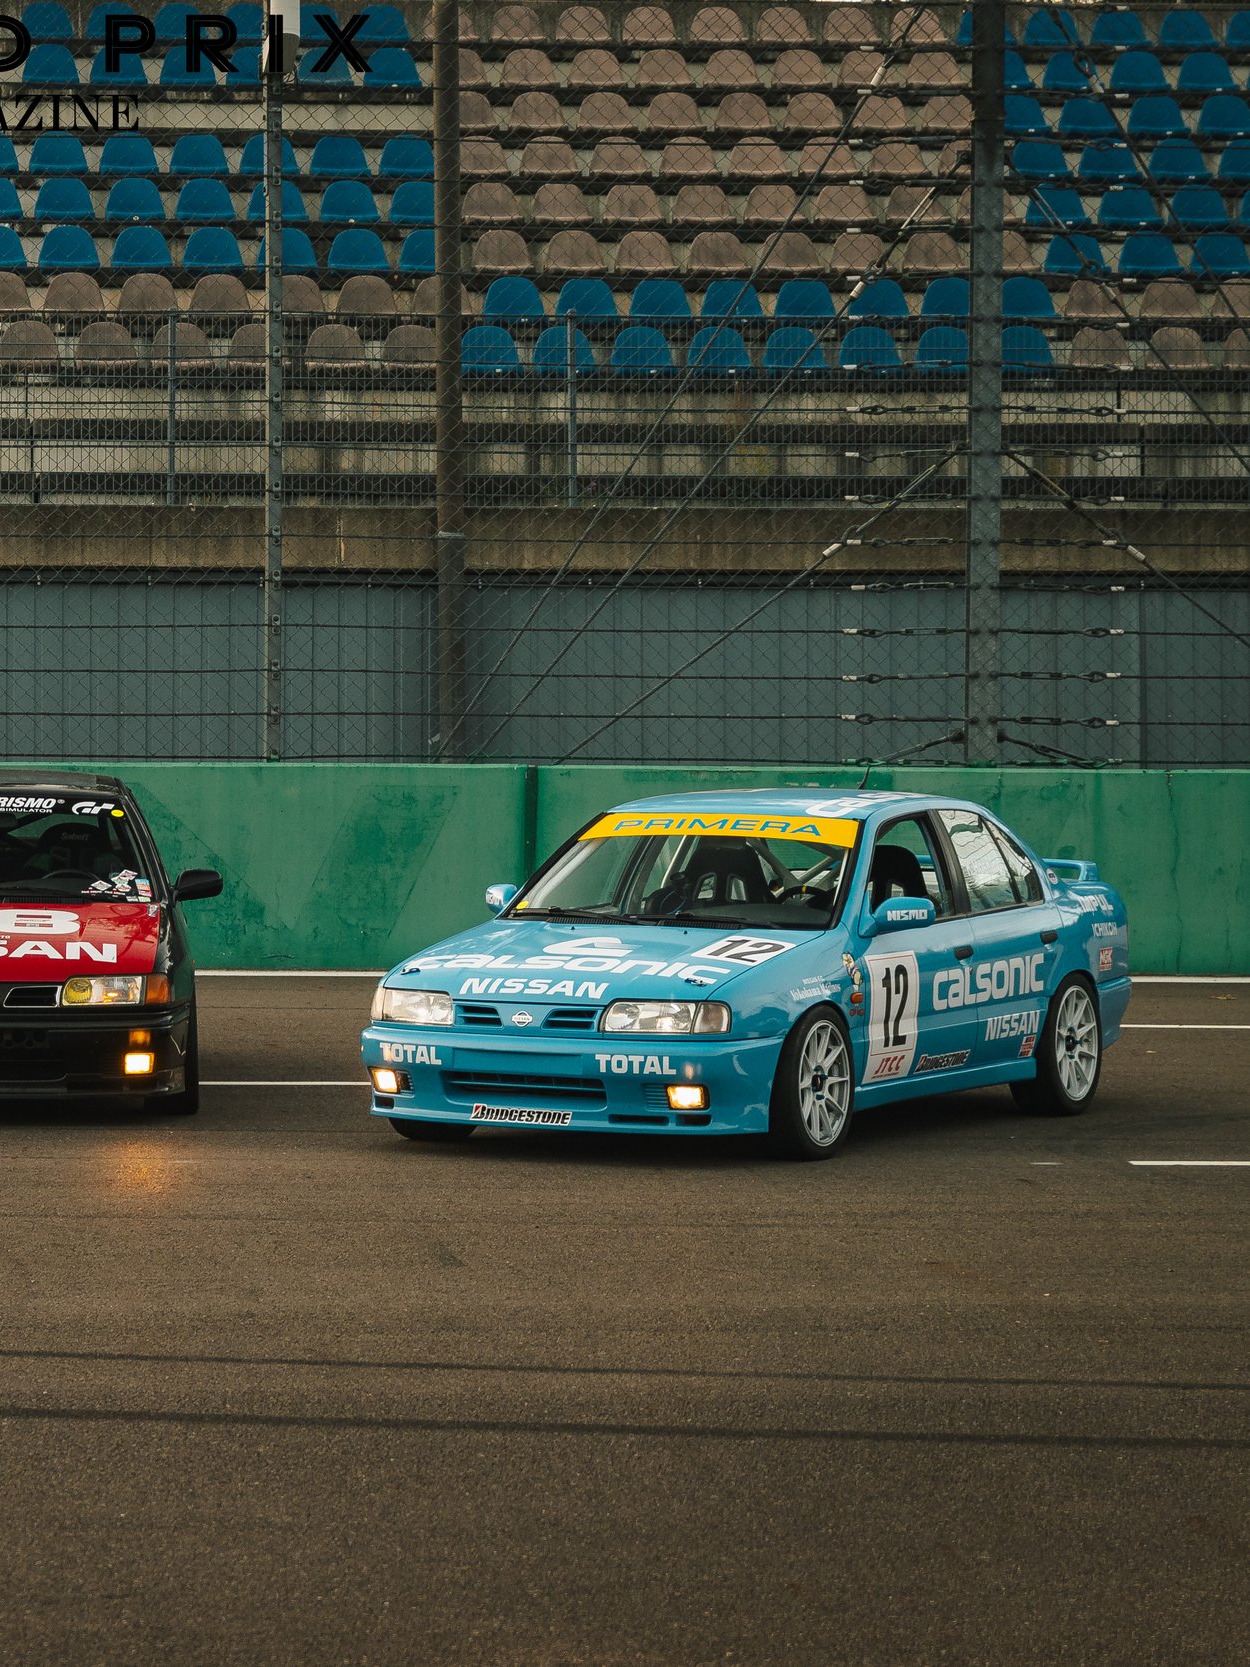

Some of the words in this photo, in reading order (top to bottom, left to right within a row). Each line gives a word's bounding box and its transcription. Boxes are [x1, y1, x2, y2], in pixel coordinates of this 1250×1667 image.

[613, 818, 822, 836] PRIMERA
[886, 909, 928, 921] NISMO
[706, 938, 786, 963] 12
[458, 977, 610, 999] NISSAN
[881, 964, 909, 1048] 12
[984, 1010, 1041, 1042] NISSAN
[379, 1042, 442, 1065] TOTAL
[595, 1054, 677, 1075] TOTAL
[874, 1055, 906, 1075] JTCC
[472, 1104, 571, 1125] BRIDGESTONE
